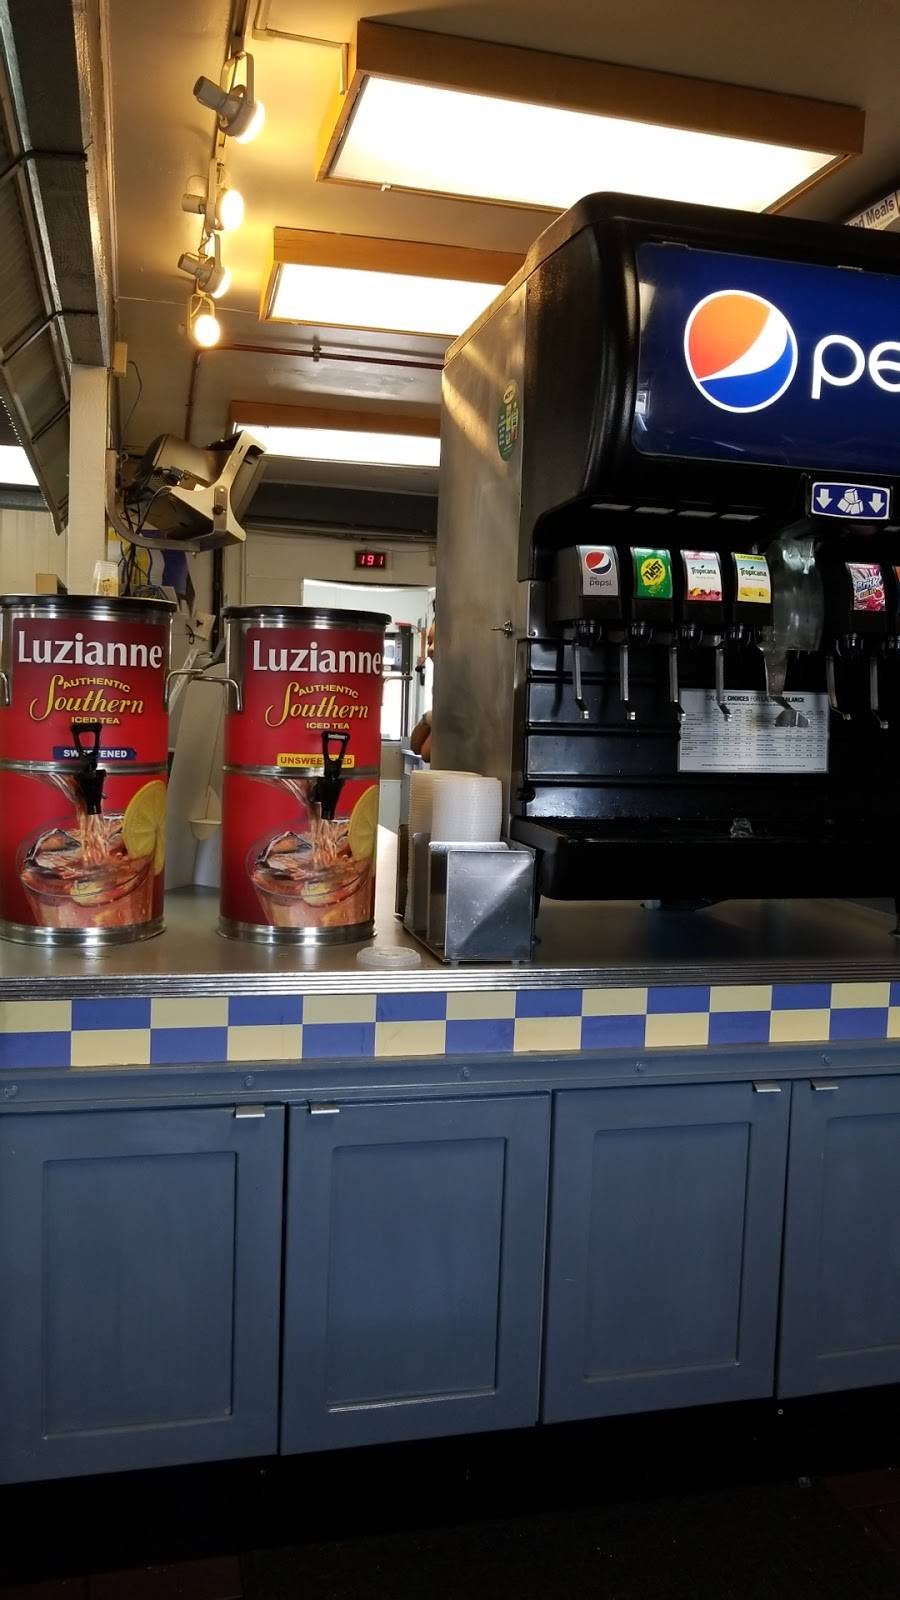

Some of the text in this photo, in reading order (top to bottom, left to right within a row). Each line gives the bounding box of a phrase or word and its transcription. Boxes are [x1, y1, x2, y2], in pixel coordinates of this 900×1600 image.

[865, 199, 895, 226] Meals
[811, 334, 900, 400] pe
[361, 555, 384, 566] 191
[690, 566, 717, 577] Tropicana
[739, 567, 767, 577] Tropicana
[589, 579, 612, 588] pepsi
[18, 630, 163, 669] Luzianne
[252, 639, 382, 675] Luzianne
[63, 677, 131, 693] AUTHENTIC
[298, 684, 359, 698] AUTHENTIC
[29, 674, 144, 721] Southern
[265, 681, 369, 727] Southern
[71, 716, 120, 725] ICED TEA
[306, 722, 331, 730] ICED
[63, 749, 129, 758] SWENED
[280, 756, 353, 766] UNSWEEED
